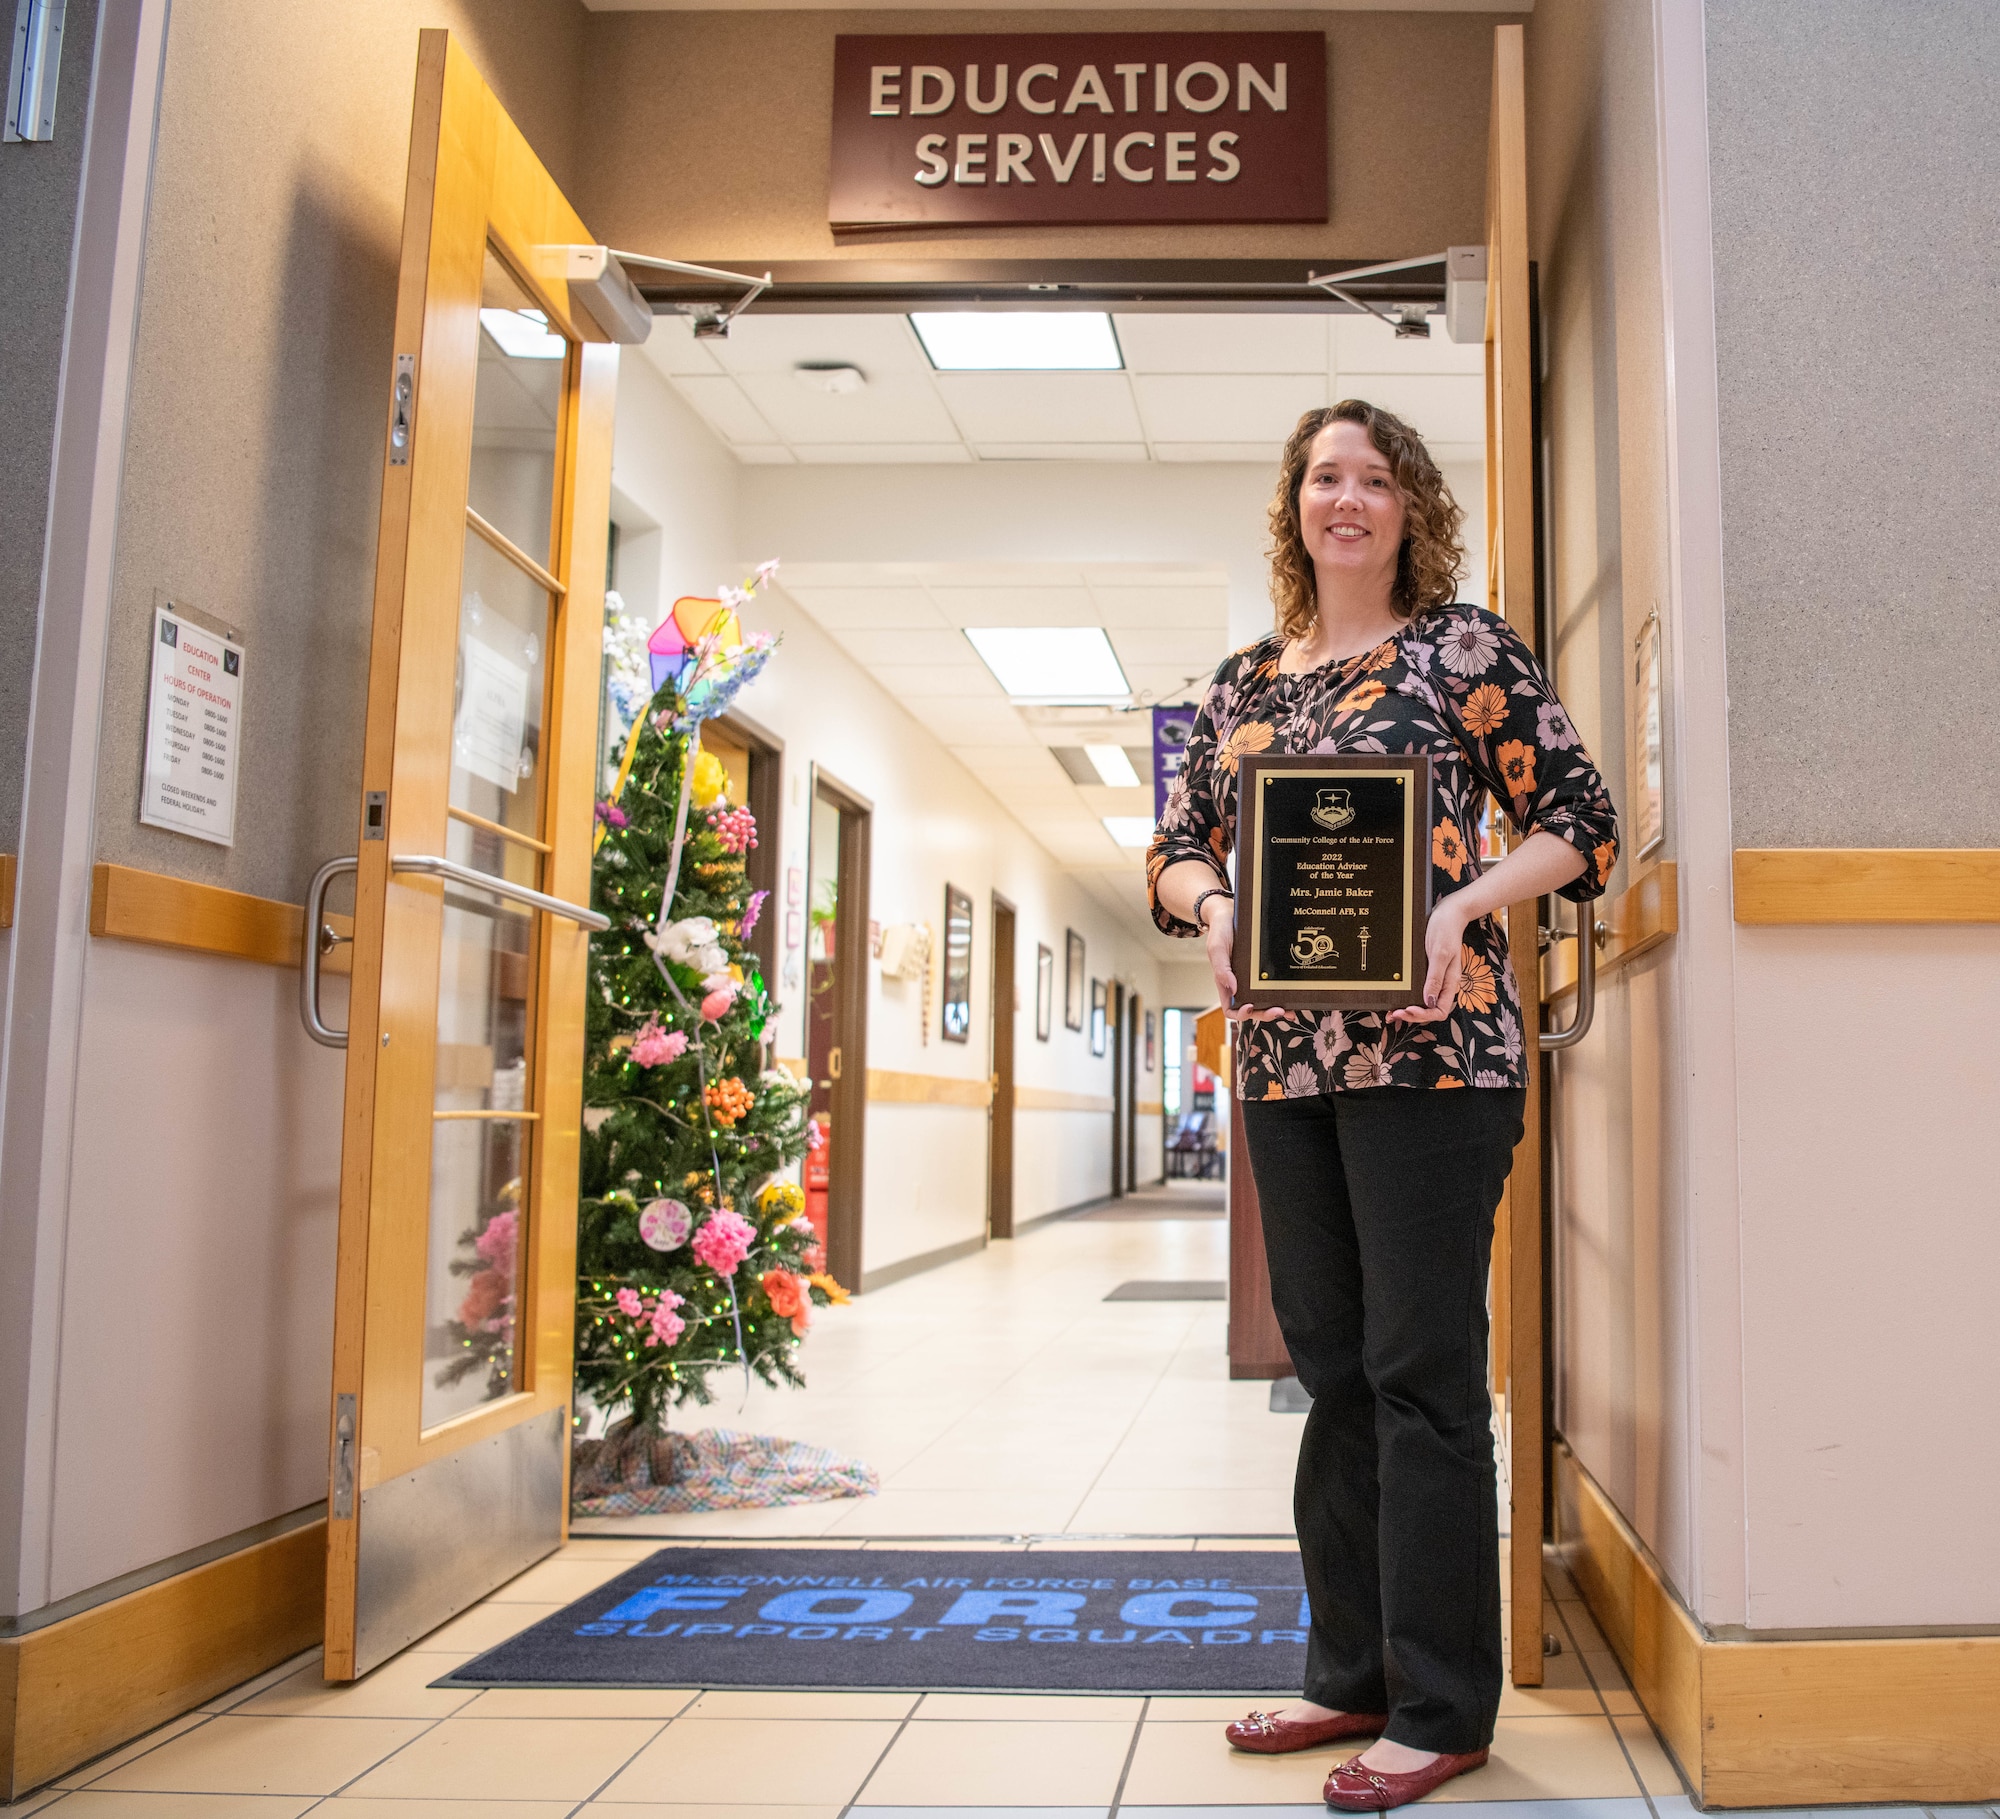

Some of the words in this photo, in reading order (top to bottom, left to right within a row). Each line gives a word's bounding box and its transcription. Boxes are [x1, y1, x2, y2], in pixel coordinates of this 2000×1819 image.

[870, 62, 1288, 115] EDUCATION
[914, 132, 1241, 185] SERVICES
[183, 642, 219, 665] EDUCATION
[187, 665, 211, 682] CENTER
[163, 673, 186, 691] HOURS
[187, 683, 196, 694] OF
[196, 687, 232, 709] OPERATION
[168, 693, 190, 708] MONDAY
[166, 708, 189, 722] TUESDAY
[165, 723, 196, 740] WEDNESDAY
[164, 737, 191, 753] THURSDAY
[163, 752, 181, 765] FRIDAY
[161, 782, 180, 795] CLOSED
[180, 789, 206, 804] WEEKENDS
[206, 798, 217, 807] AND
[161, 795, 182, 808] FEDERAL
[1271, 836, 1311, 845] Community
[1312, 836, 1338, 845] College
[1339, 836, 1348, 844] of
[1349, 836, 1361, 844] the
[1362, 836, 1374, 844] Air
[1375, 836, 1395, 844] Force
[1321, 853, 1343, 861] 2022
[1296, 862, 1335, 870] Education
[1337, 862, 1368, 870] Advisor
[1309, 871, 1319, 879] of
[1321, 871, 1334, 879] the
[1336, 871, 1355, 879] Year
[1289, 887, 1312, 897] Mrs.
[1314, 887, 1343, 899] Jamie
[1345, 887, 1374, 897] Baker
[1293, 907, 1337, 916] McConnell
[1338, 907, 1357, 917] AFB,
[1358, 907, 1370, 916] KS
[654, 1574, 892, 1589] McCONNELL
[900, 1576, 973, 1589] AIR
[984, 1577, 1116, 1590] FORCE
[1127, 1578, 1233, 1591] BASE
[600, 1586, 1312, 1627] FORC
[574, 1622, 945, 1641] SUPPORT
[973, 1626, 1308, 1645] SQUADR
